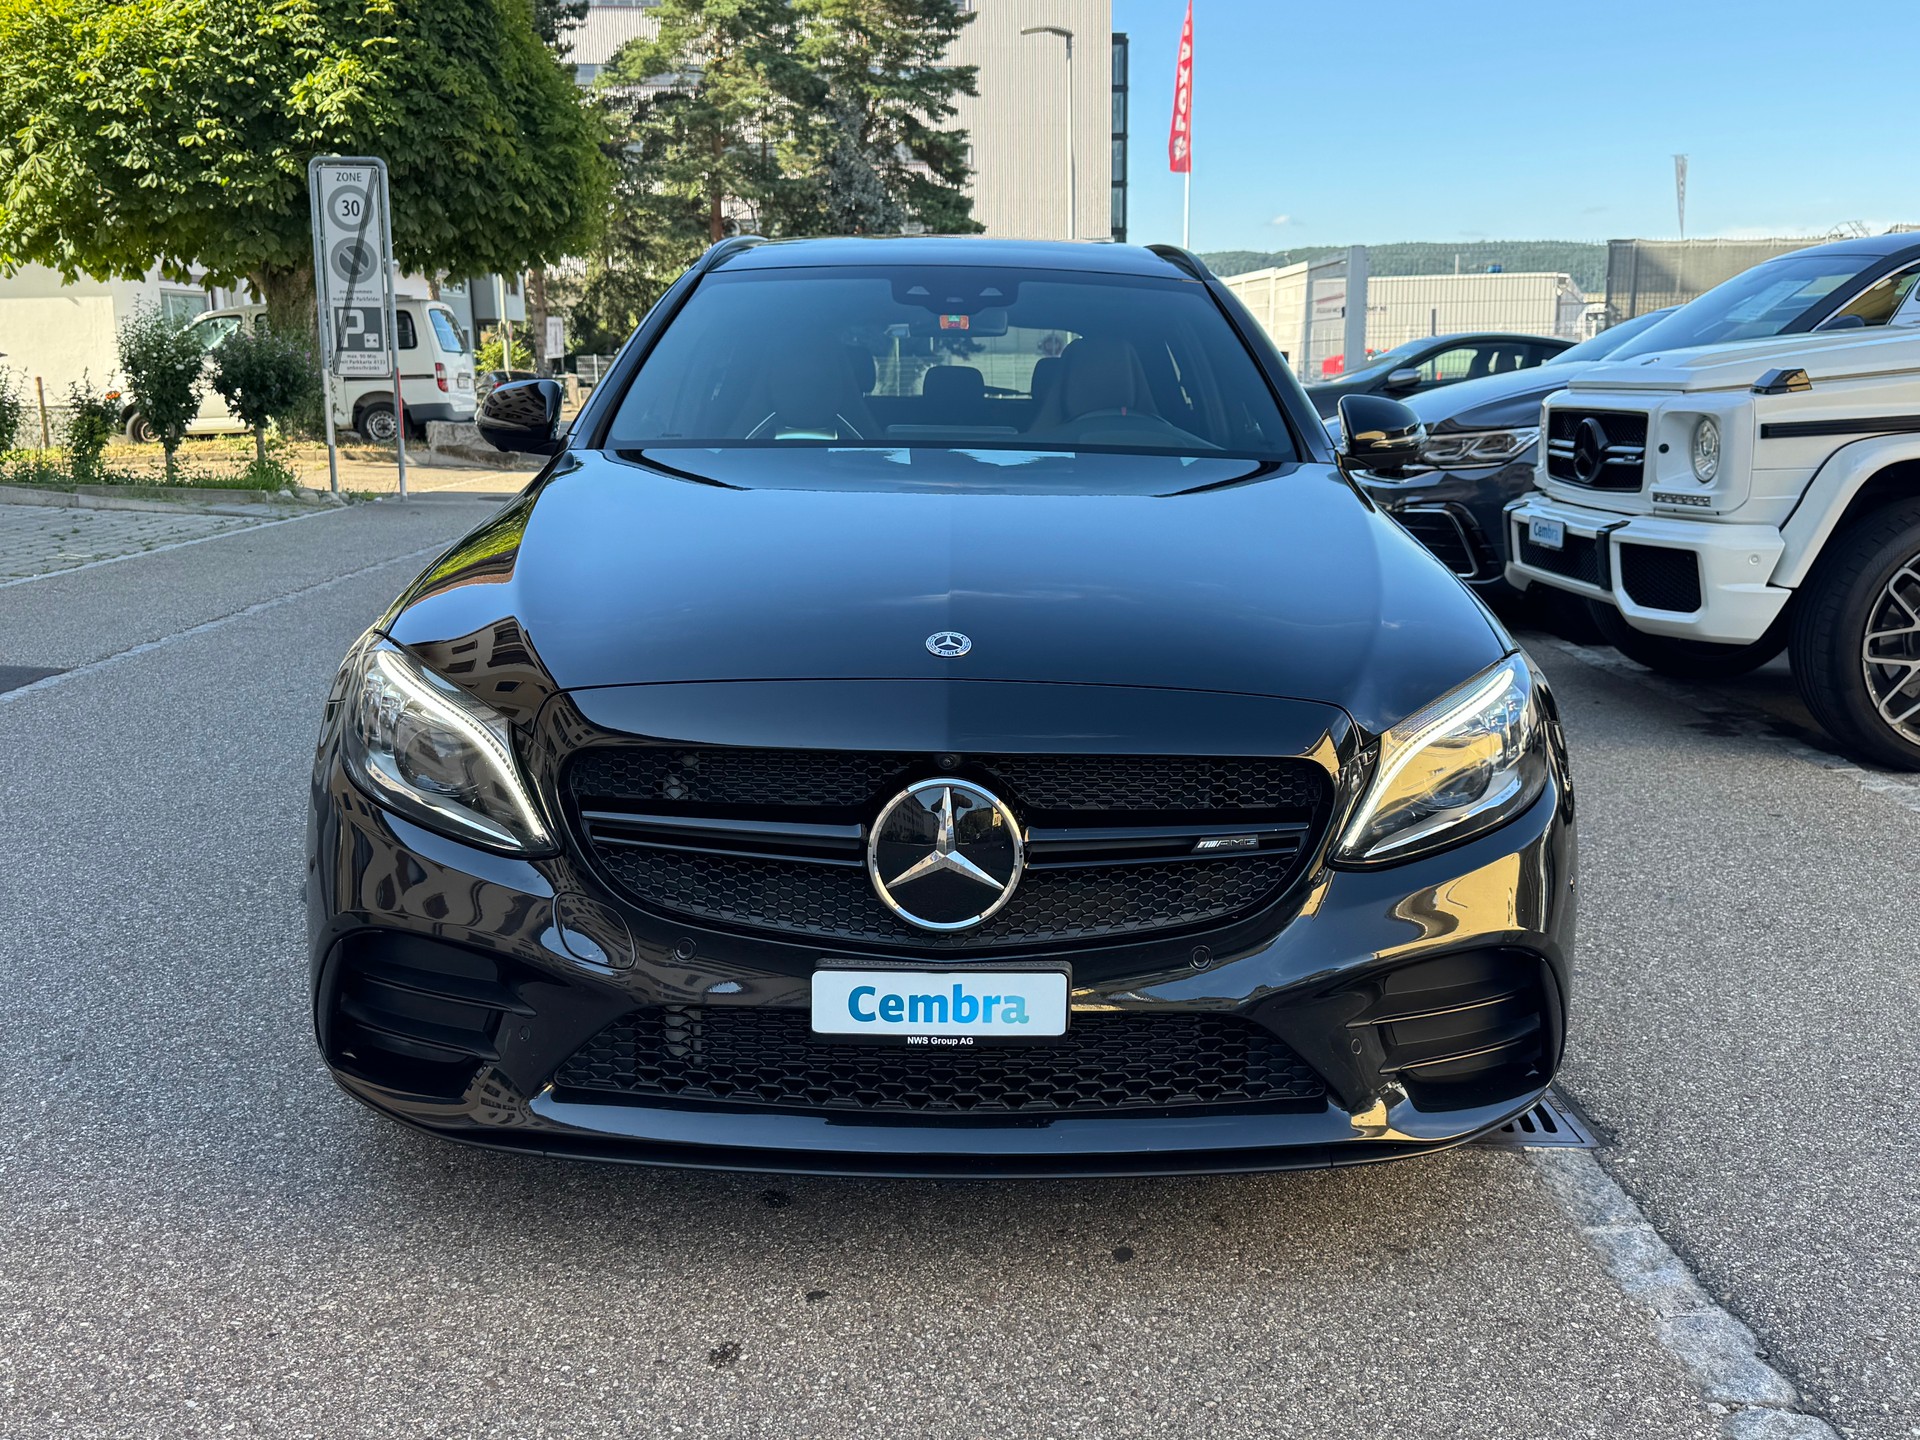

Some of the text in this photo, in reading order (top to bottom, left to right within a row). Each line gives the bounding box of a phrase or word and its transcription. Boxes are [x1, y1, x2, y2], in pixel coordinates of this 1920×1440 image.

[336, 172, 362, 182] ZONE
[342, 200, 360, 217] 30
[1534, 521, 1559, 541] Cembra
[1216, 838, 1257, 847] AMG
[848, 983, 1030, 1024] Cembra
[907, 1036, 974, 1047] NWS Group AG
